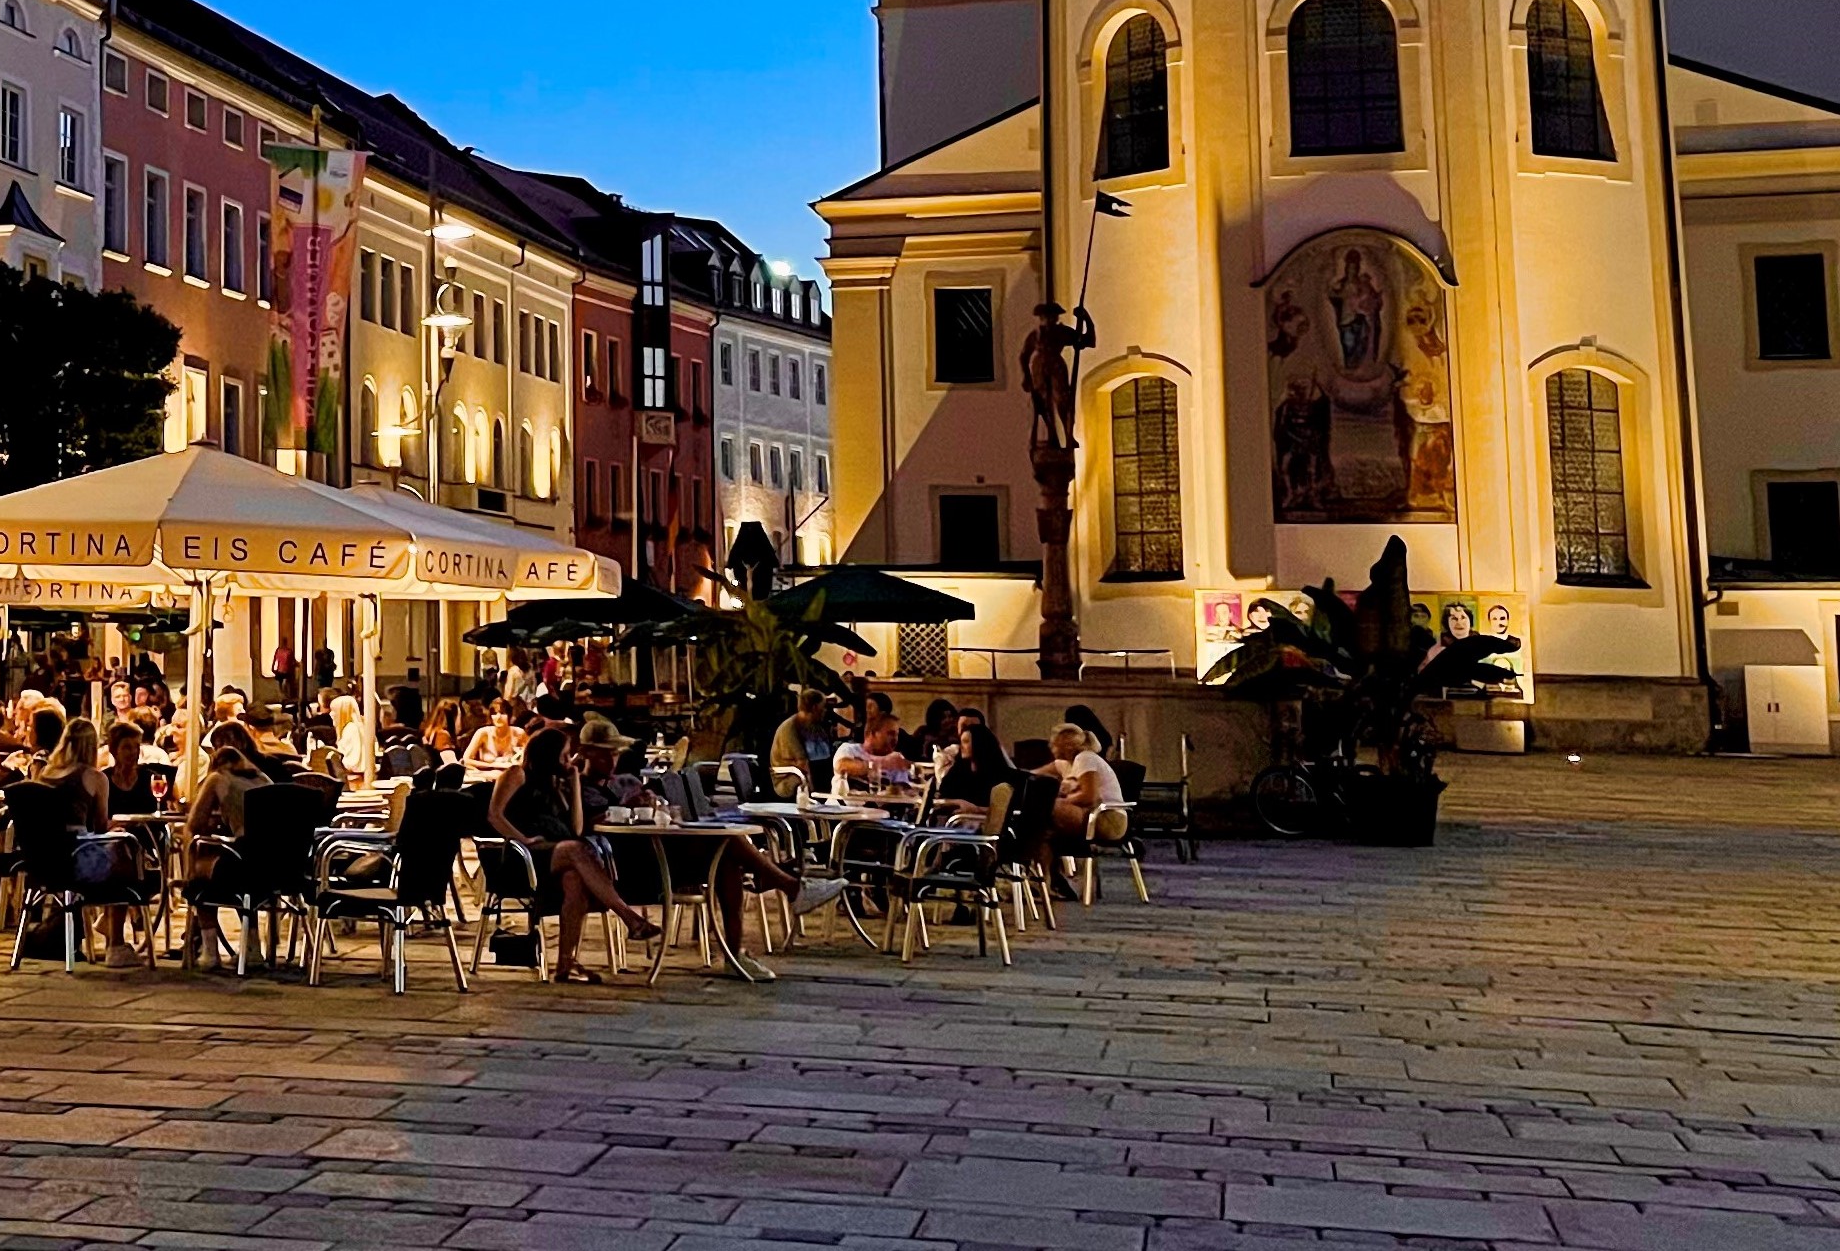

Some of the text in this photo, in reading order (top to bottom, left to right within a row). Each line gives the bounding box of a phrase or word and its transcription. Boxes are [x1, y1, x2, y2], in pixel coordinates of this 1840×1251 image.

[183, 535, 387, 570] EIS CAFÉ
[425, 549, 507, 581] CORTINA
[525, 558, 579, 582] AFÉ
[35, 582, 133, 599] RTINA
